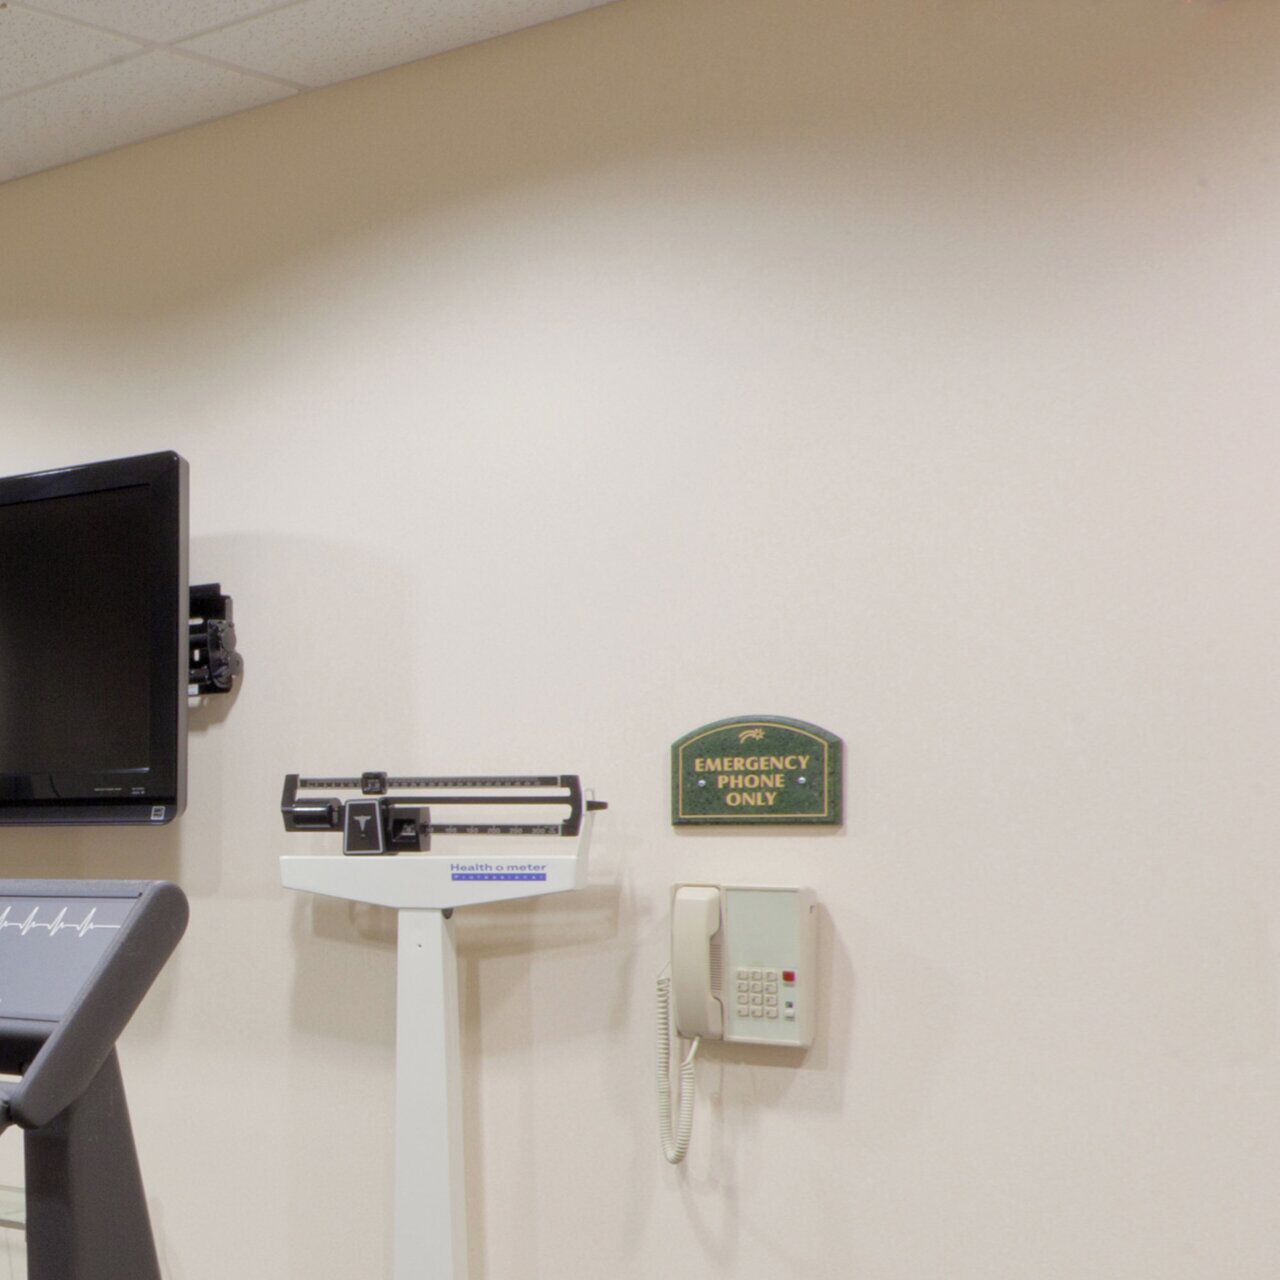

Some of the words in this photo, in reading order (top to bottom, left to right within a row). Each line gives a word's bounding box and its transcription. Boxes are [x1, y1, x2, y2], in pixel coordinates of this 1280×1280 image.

[694, 755, 810, 772] EMERGENCY
[717, 774, 785, 789] PHONE
[726, 792, 777, 806] ONLY
[450, 864, 492, 872] Health
[506, 864, 547, 872] meter
